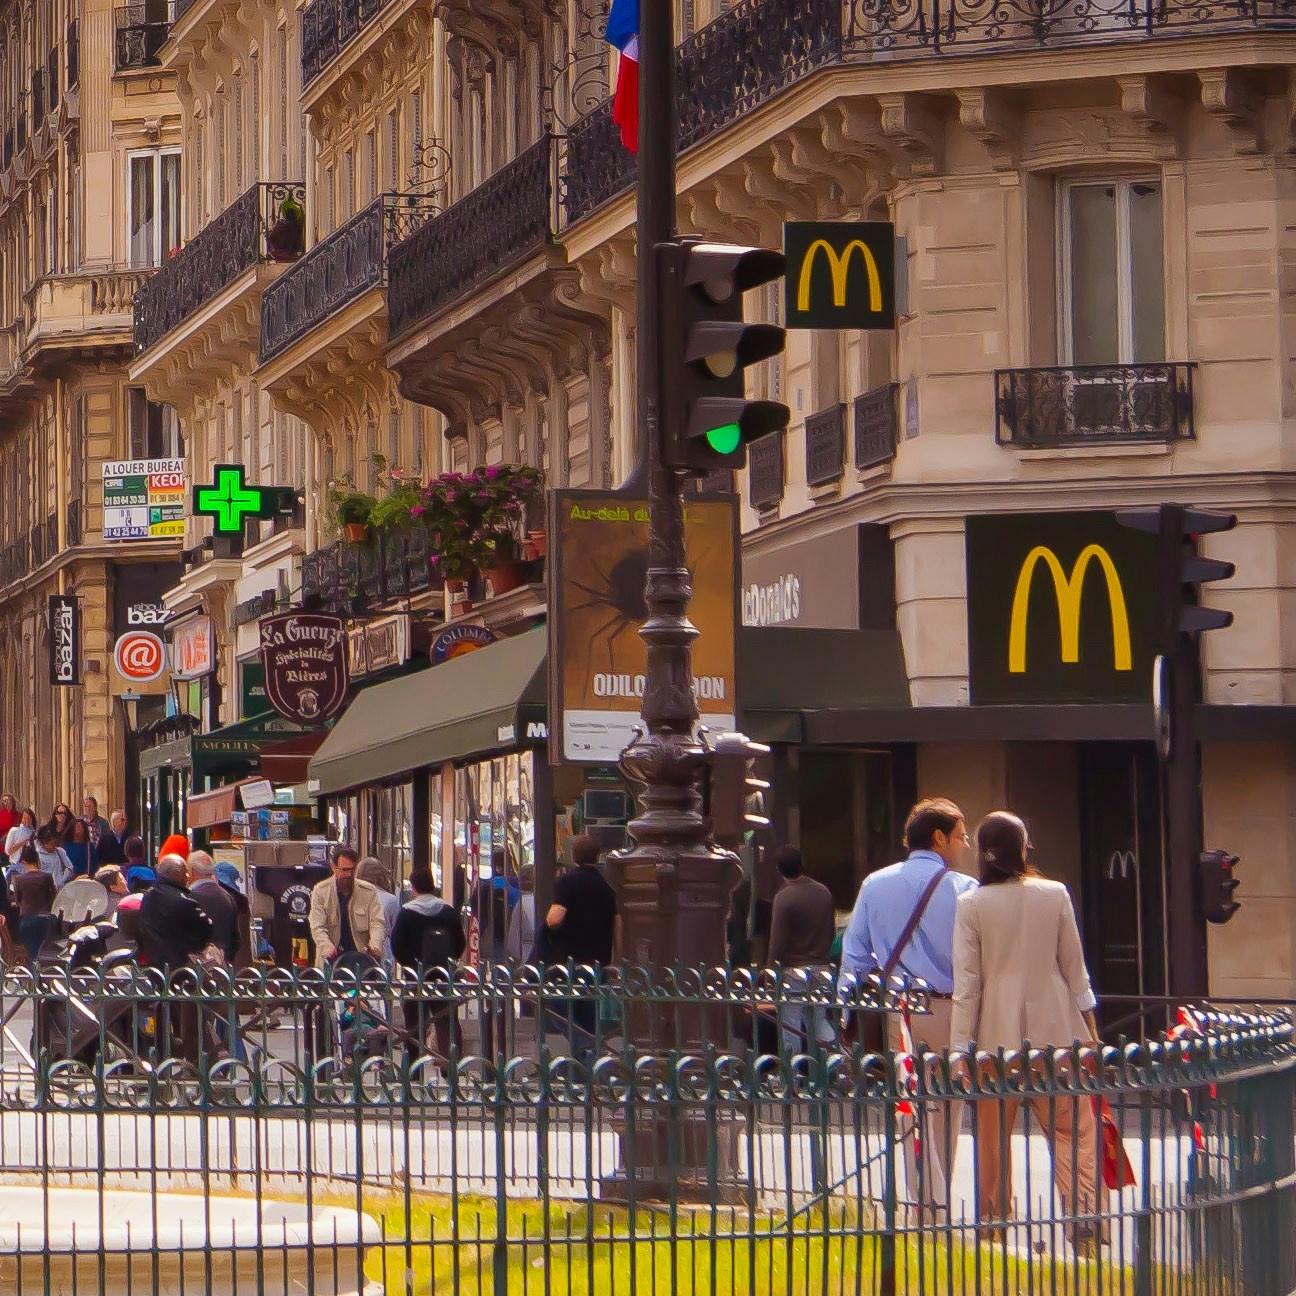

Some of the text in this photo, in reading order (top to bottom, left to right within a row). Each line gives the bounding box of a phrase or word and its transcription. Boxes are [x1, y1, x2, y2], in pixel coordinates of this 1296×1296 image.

[104, 465, 111, 475] A
[113, 462, 145, 474] LOUER
[1008, 543, 1133, 673] M
[57, 600, 73, 681] bazar
[593, 672, 647, 697] ODILO
